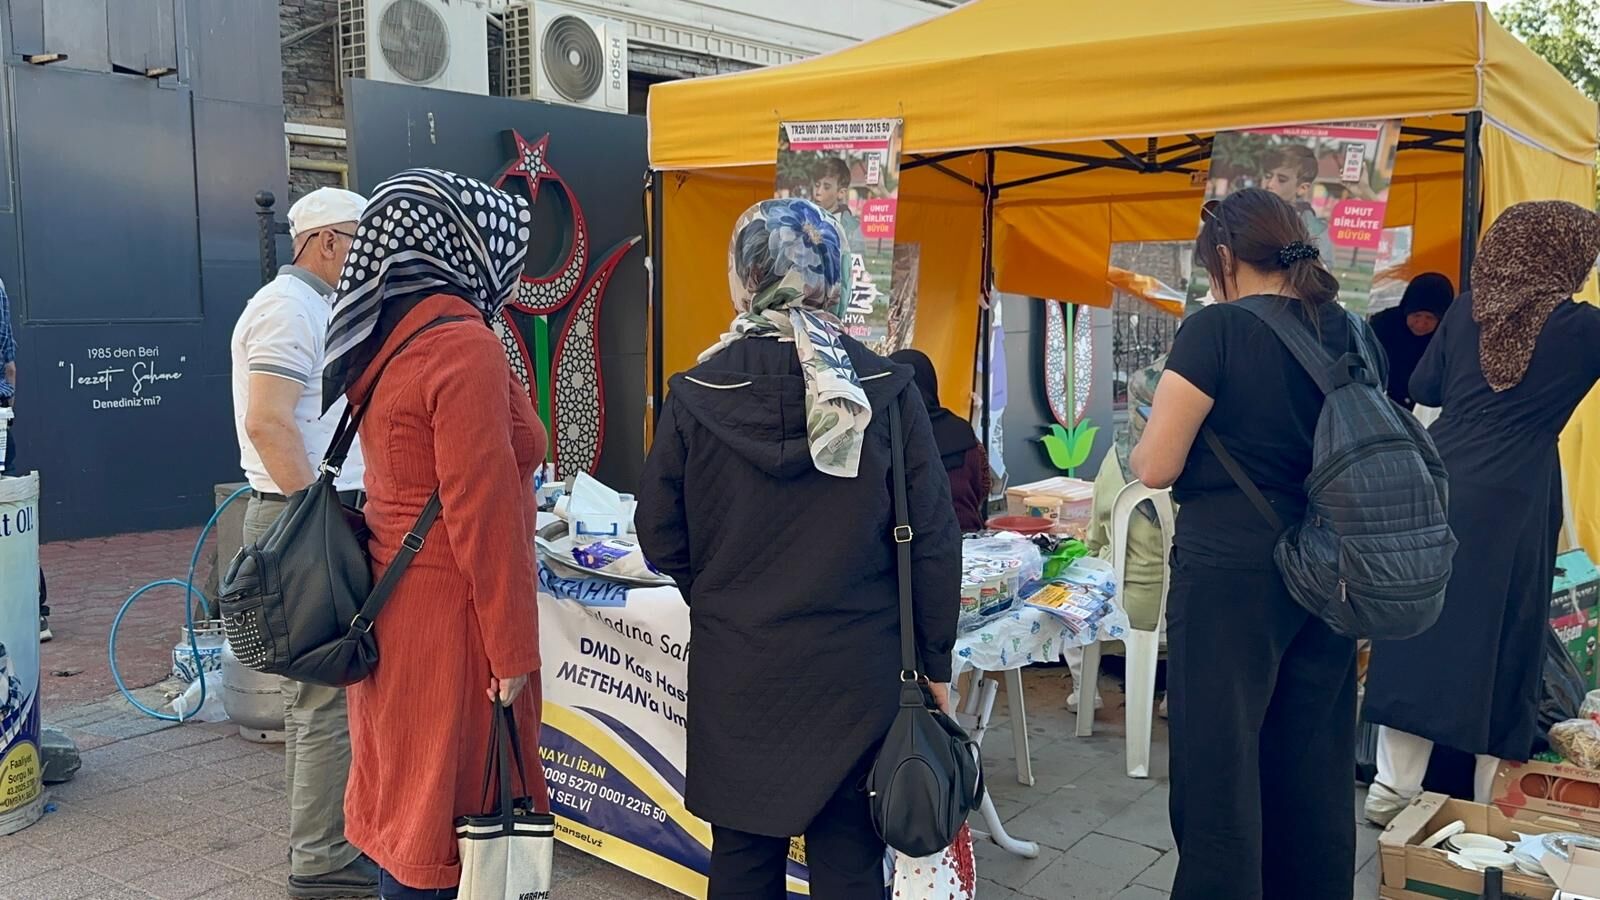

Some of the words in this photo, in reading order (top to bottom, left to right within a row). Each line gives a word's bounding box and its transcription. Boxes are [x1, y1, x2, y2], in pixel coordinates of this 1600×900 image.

[612, 38, 621, 90] BOSCH
[791, 125, 805, 135] TR25
[806, 124, 818, 135] 0001
[820, 124, 833, 134] 2009
[834, 123, 848, 134] 5270
[850, 123, 864, 133] 0001
[866, 122, 881, 133] 2215
[882, 122, 890, 132] 50
[870, 204, 889, 212] UMUT
[1344, 206, 1373, 216] UMUT
[864, 213, 893, 222] BİRLİKTE
[1334, 216, 1379, 230] BİRLİKTE
[867, 223, 889, 232] BÜYÜR
[1337, 229, 1371, 240] BÜYÜR
[88, 348, 111, 359] 1985
[113, 347, 136, 358] den
[138, 346, 159, 357] Beri
[93, 396, 161, 409] Denediniz'mi?
[16, 506, 33, 534] Ol!
[581, 637, 621, 666] DMD
[625, 653, 652, 684] Kas
[656, 670, 688, 702] Has
[556, 661, 659, 713] METEHAN'a
[576, 755, 606, 779] İBAN
[556, 790, 592, 813] SELVİ
[568, 775, 598, 795] 5270
[598, 786, 625, 806] 0001
[626, 796, 651, 816] 2215
[653, 806, 666, 823] 50
